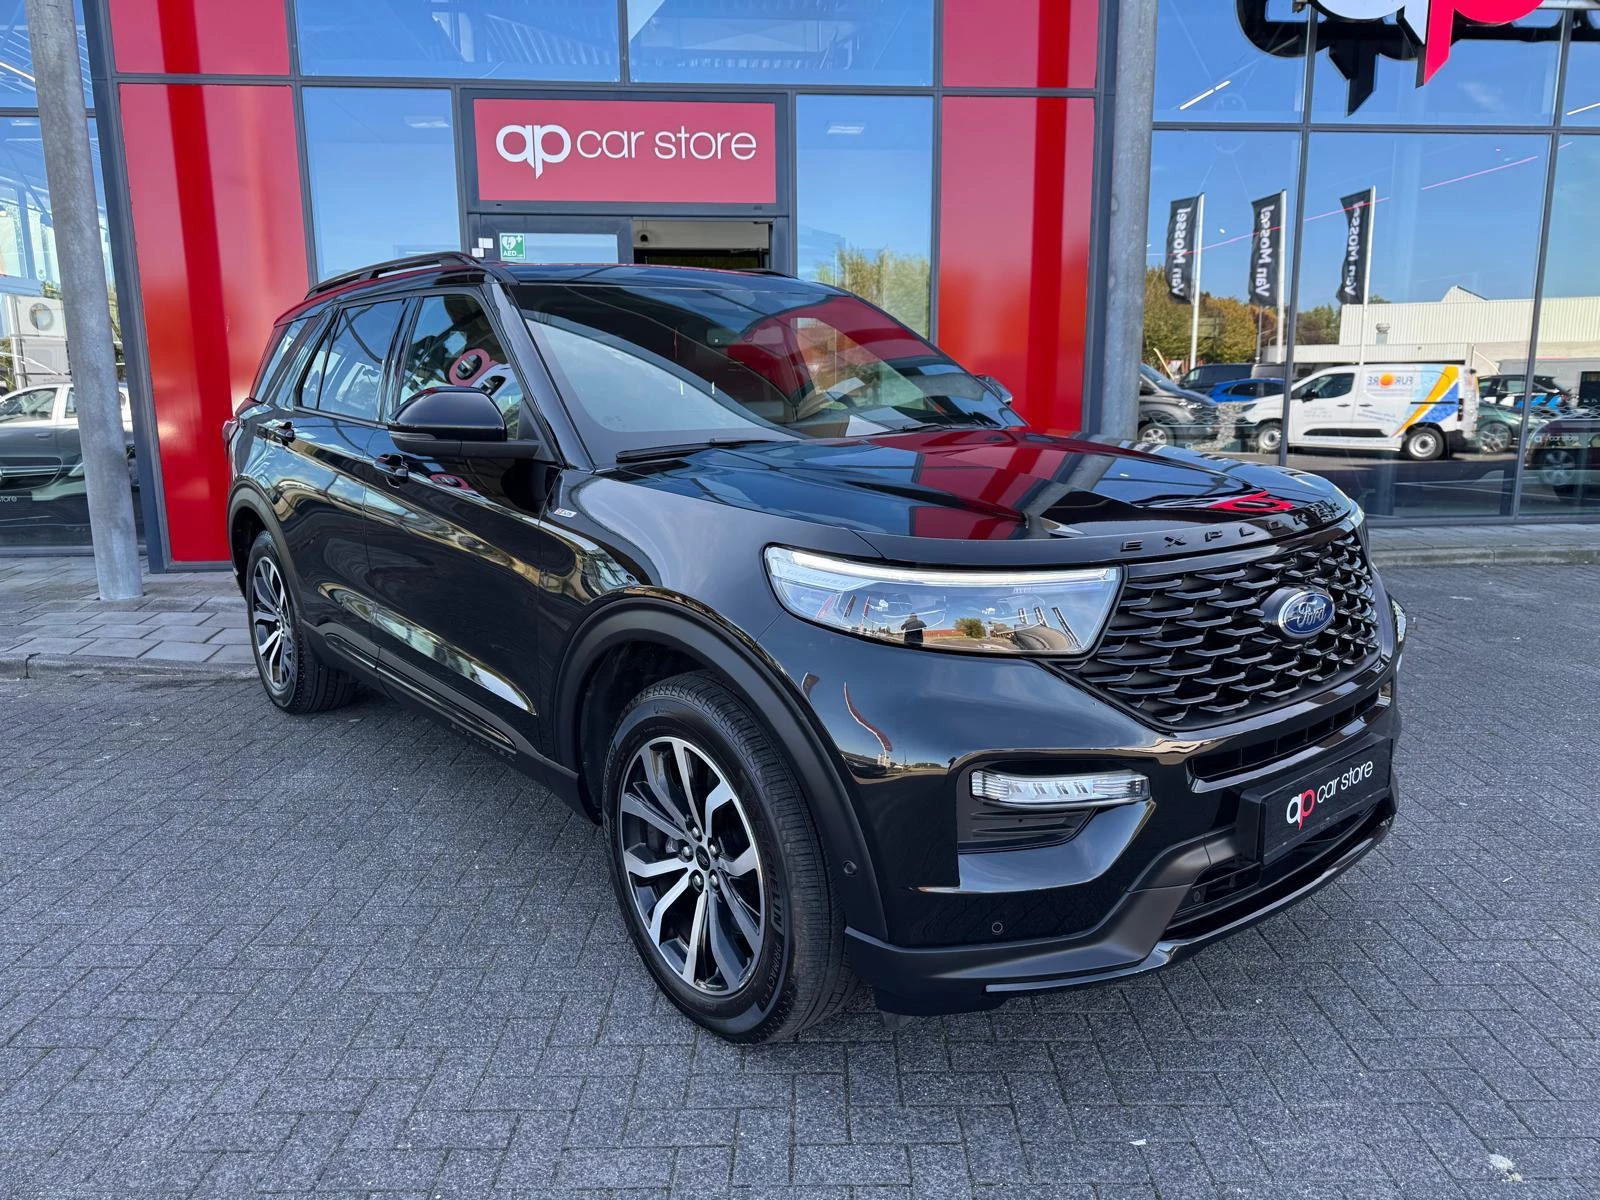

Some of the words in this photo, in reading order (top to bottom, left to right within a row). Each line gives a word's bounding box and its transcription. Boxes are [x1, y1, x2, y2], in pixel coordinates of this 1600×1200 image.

[495, 124, 572, 180] ap
[576, 129, 646, 159] car
[653, 125, 757, 161] store
[1295, 600, 1327, 627] Ford
[1286, 789, 1315, 830] ap
[1316, 777, 1340, 804] car
[1341, 761, 1373, 790] store
